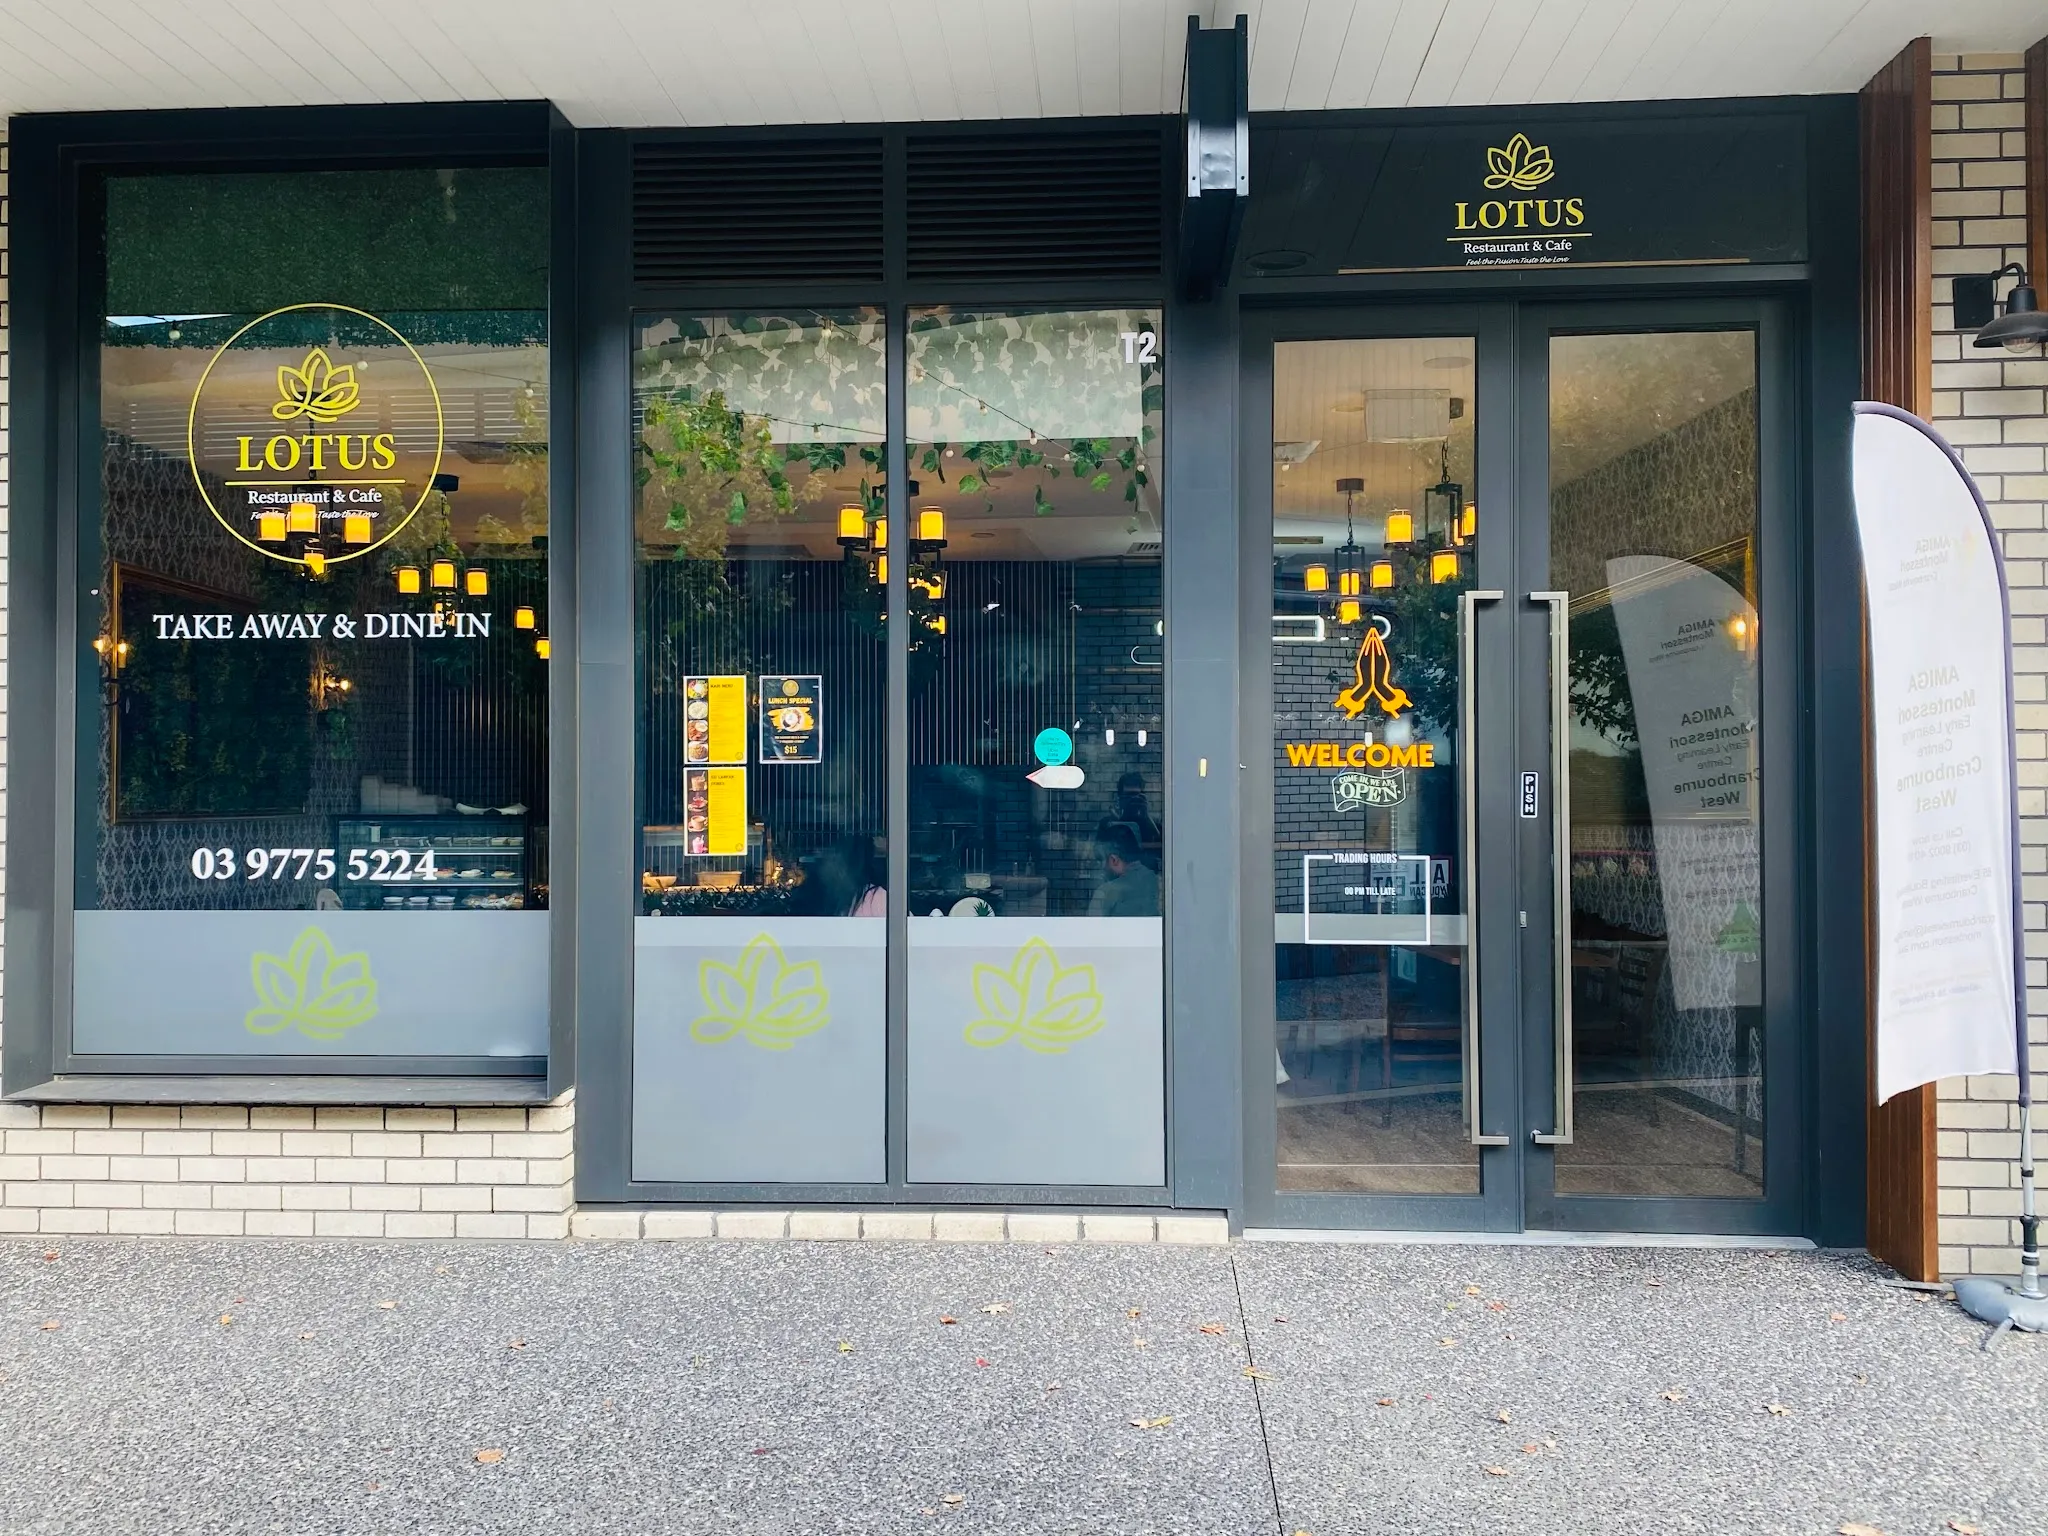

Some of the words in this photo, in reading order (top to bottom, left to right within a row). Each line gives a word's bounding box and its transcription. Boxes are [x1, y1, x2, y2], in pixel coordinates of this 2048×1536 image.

[1454, 198, 1585, 230] LOTUS
[1463, 242, 1530, 254] Restaurant
[1532, 241, 1543, 251] &
[1545, 239, 1573, 251] Cafe
[1466, 257, 1482, 266] Feel
[1481, 257, 1495, 265] the
[1539, 256, 1553, 264] the
[1553, 255, 1570, 263] Love
[1121, 331, 1157, 364] T2
[235, 433, 397, 471] LOTUS
[248, 490, 330, 504] Restaurant
[333, 490, 346, 503] &
[349, 488, 382, 503] Cafe
[317, 511, 342, 519] Taste
[152, 613, 234, 639] TAKE
[239, 613, 327, 639] AWAY
[332, 613, 356, 639] &
[364, 612, 447, 638] DINE
[453, 612, 492, 638] IN
[784, 745, 798, 754] $15
[1286, 743, 1435, 767] WELCOME
[1339, 775, 1358, 784] COME
[1370, 778, 1381, 787] WE
[1382, 779, 1397, 788] ARE
[1340, 781, 1399, 803] OPEN
[1525, 775, 1535, 813] PUSH
[191, 848, 236, 880] 03
[246, 848, 336, 880] 9775
[346, 849, 439, 881] 5224
[1333, 853, 1369, 864] TRADING
[1370, 853, 1398, 864] HOURS
[1354, 887, 1365, 896] PM
[1366, 887, 1380, 896] TILL
[1380, 887, 1397, 896] LATE
